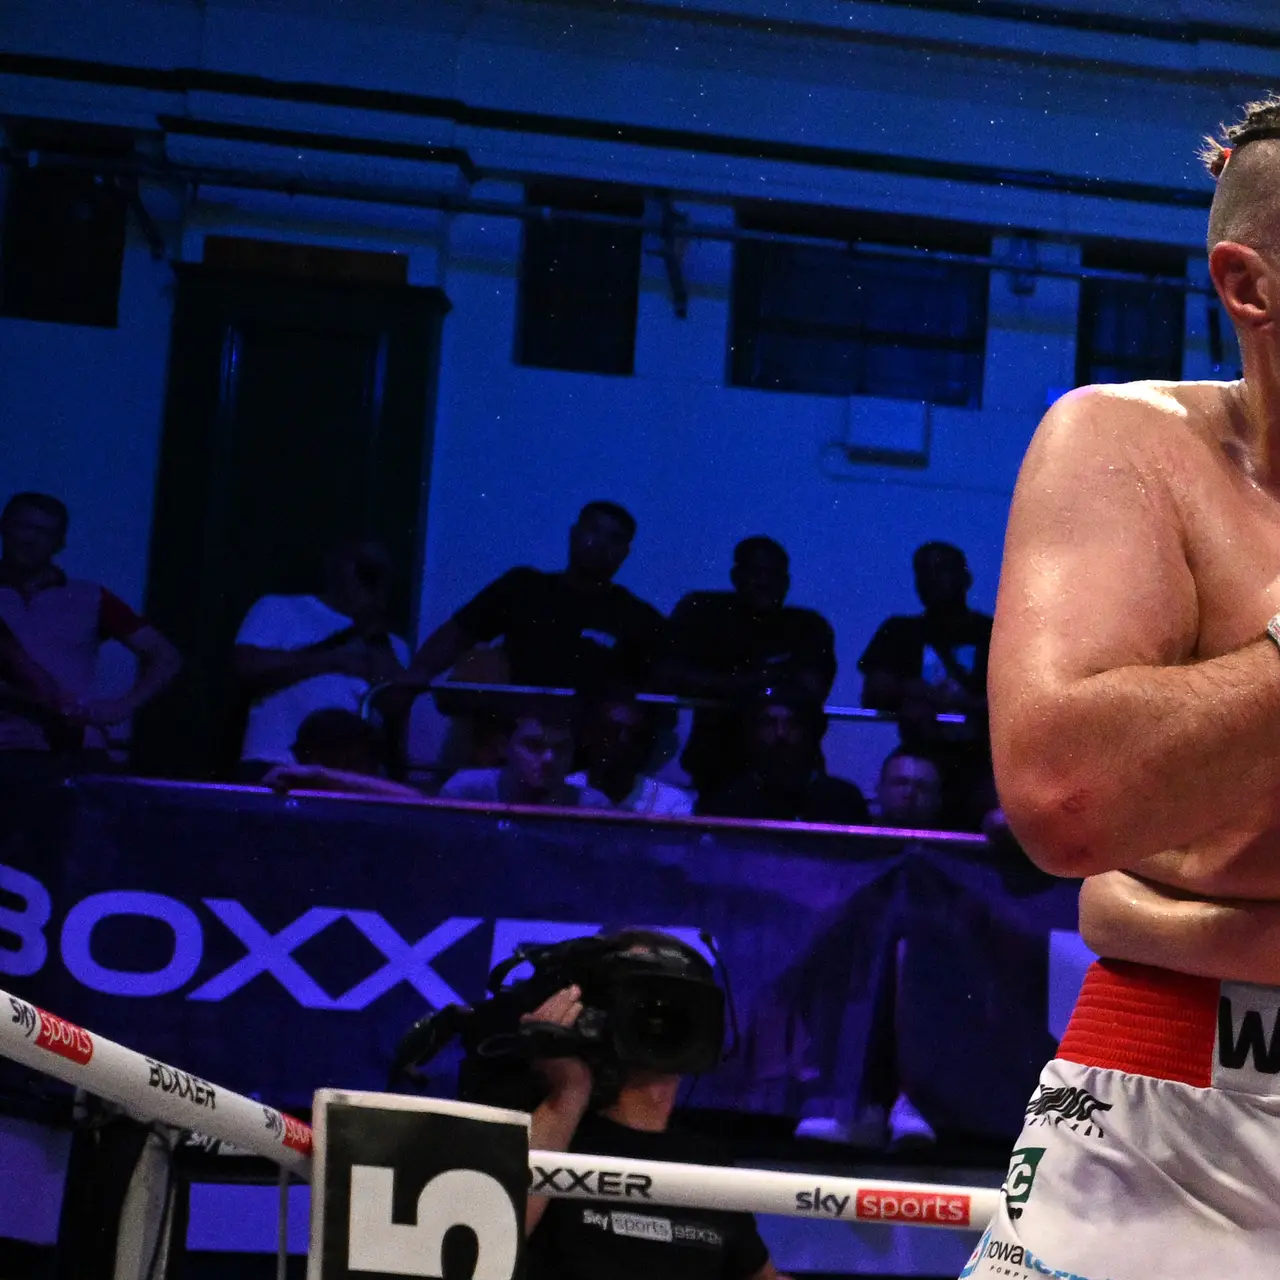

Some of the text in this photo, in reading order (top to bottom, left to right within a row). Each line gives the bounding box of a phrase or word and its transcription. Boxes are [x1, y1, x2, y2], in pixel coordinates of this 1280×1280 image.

[0, 865, 722, 1012] BOXXE
[40, 1010, 93, 1055] sports
[795, 1186, 850, 1217] sky
[862, 1191, 964, 1225] sports
